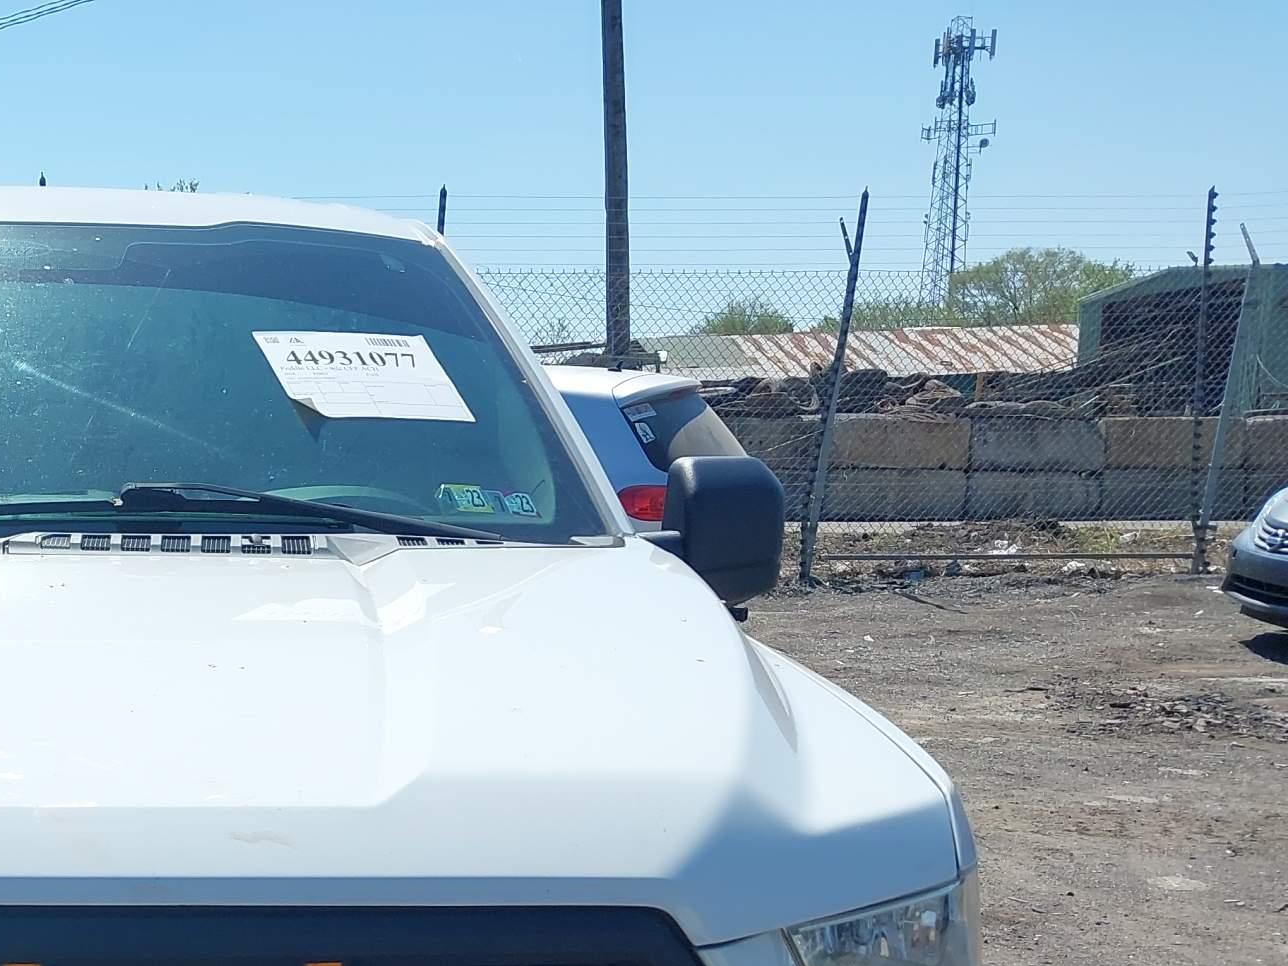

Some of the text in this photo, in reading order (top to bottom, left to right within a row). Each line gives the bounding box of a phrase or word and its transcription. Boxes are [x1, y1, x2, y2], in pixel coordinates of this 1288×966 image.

[286, 350, 415, 367] 44931077
[465, 489, 485, 507] 23
[515, 495, 535, 512] 23
